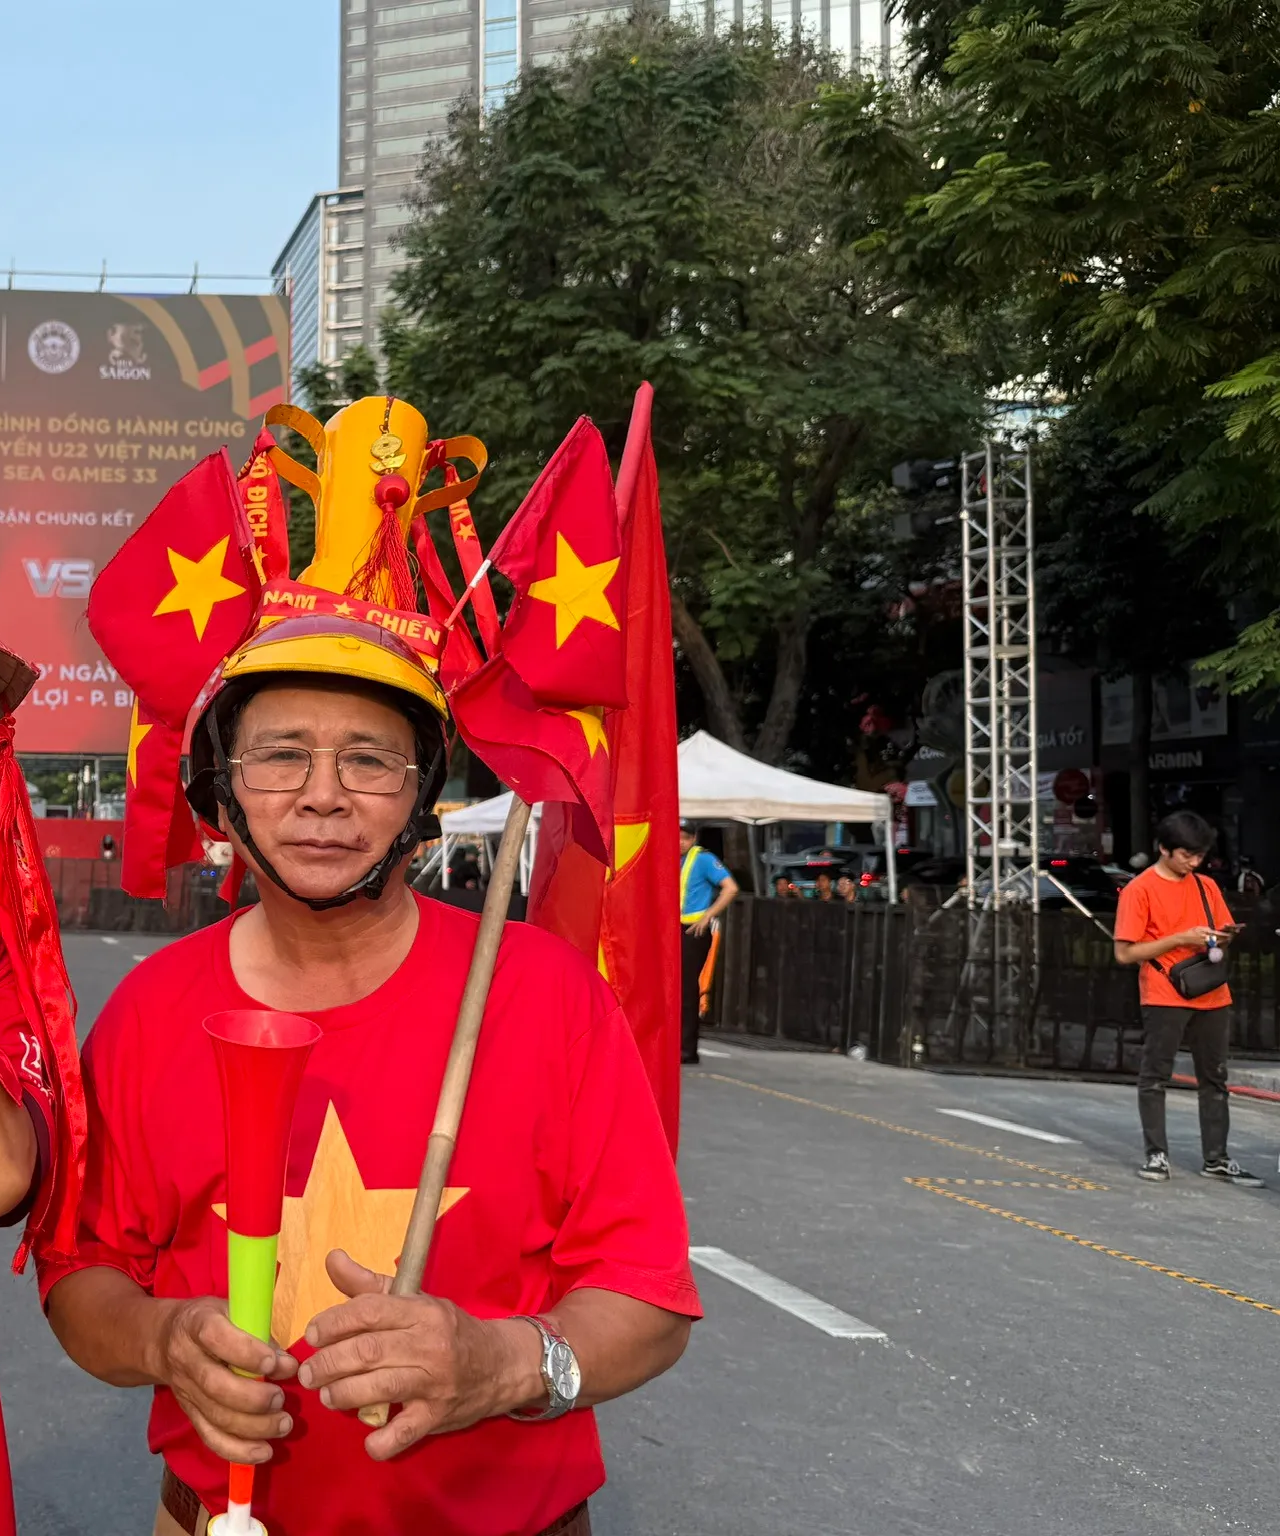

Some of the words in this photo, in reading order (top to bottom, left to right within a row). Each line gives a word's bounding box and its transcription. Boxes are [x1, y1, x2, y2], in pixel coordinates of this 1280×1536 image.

[99, 366, 151, 380] SAIGON
[48, 411, 111, 436] ĐỒNG
[118, 413, 180, 437] HÀNH
[185, 415, 246, 438] CÙNG
[49, 440, 88, 459] U22
[94, 440, 142, 463] VIỆT
[149, 444, 196, 461] NAM
[4, 466, 47, 481] SEA
[53, 467, 126, 483] GAMES
[132, 468, 157, 484] 33
[36, 511, 96, 525] CHUNG
[101, 508, 135, 527] KẾT
[23, 558, 95, 598] VS
[263, 590, 318, 611] NAM
[365, 608, 441, 647] CHIẾN
